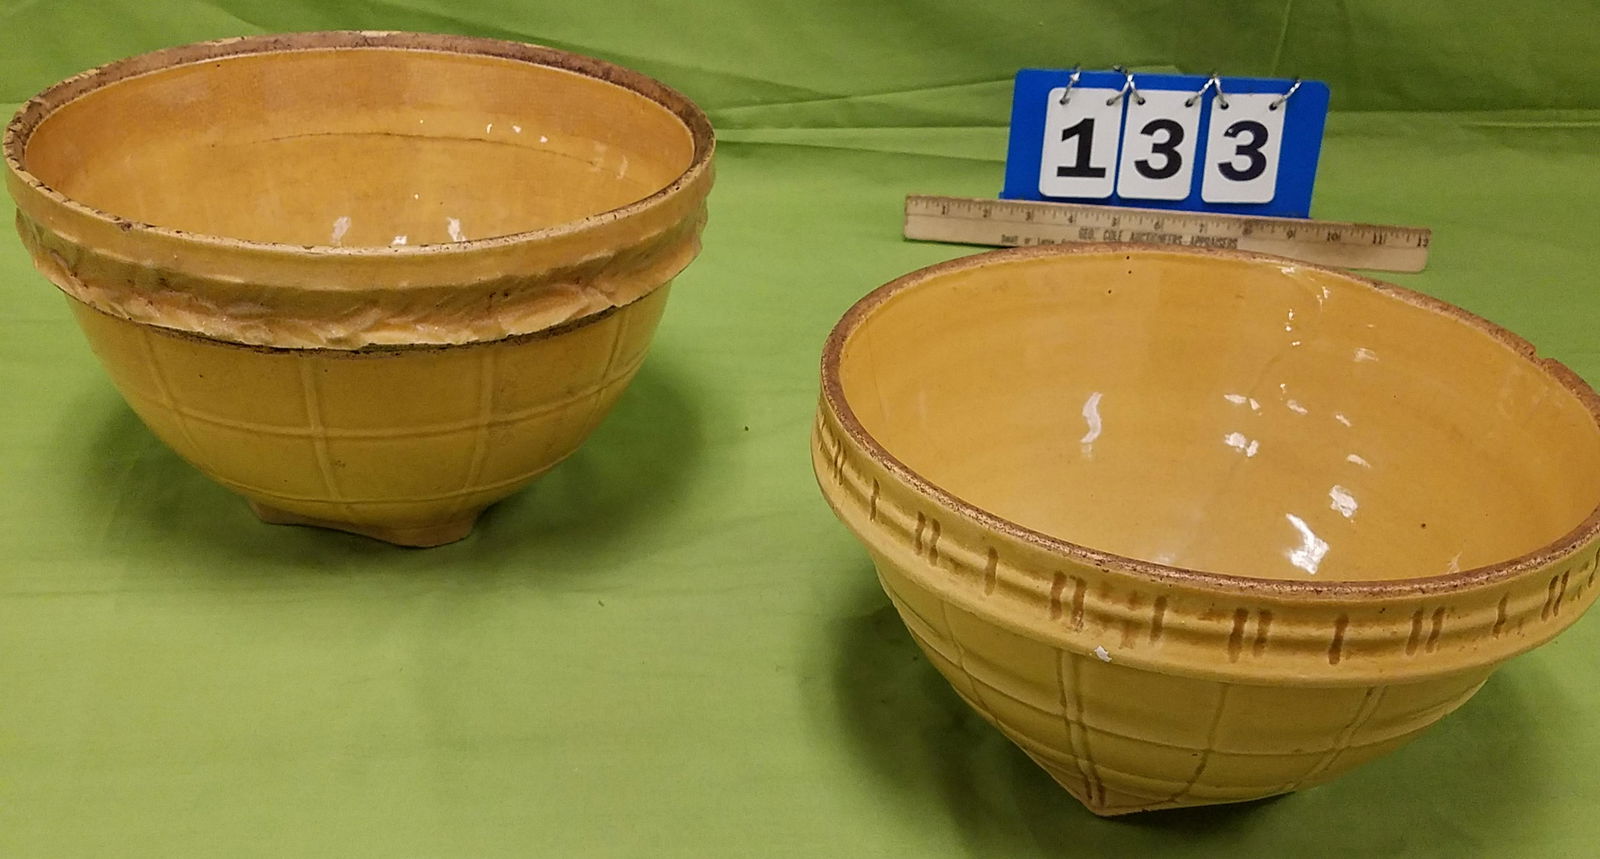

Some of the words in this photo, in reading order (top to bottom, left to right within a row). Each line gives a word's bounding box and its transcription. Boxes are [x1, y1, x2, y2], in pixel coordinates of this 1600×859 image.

[1056, 117, 1269, 182] 133
[1103, 229, 1123, 242] COLE
[1326, 231, 1339, 242] 10
[1372, 232, 1382, 245] 11
